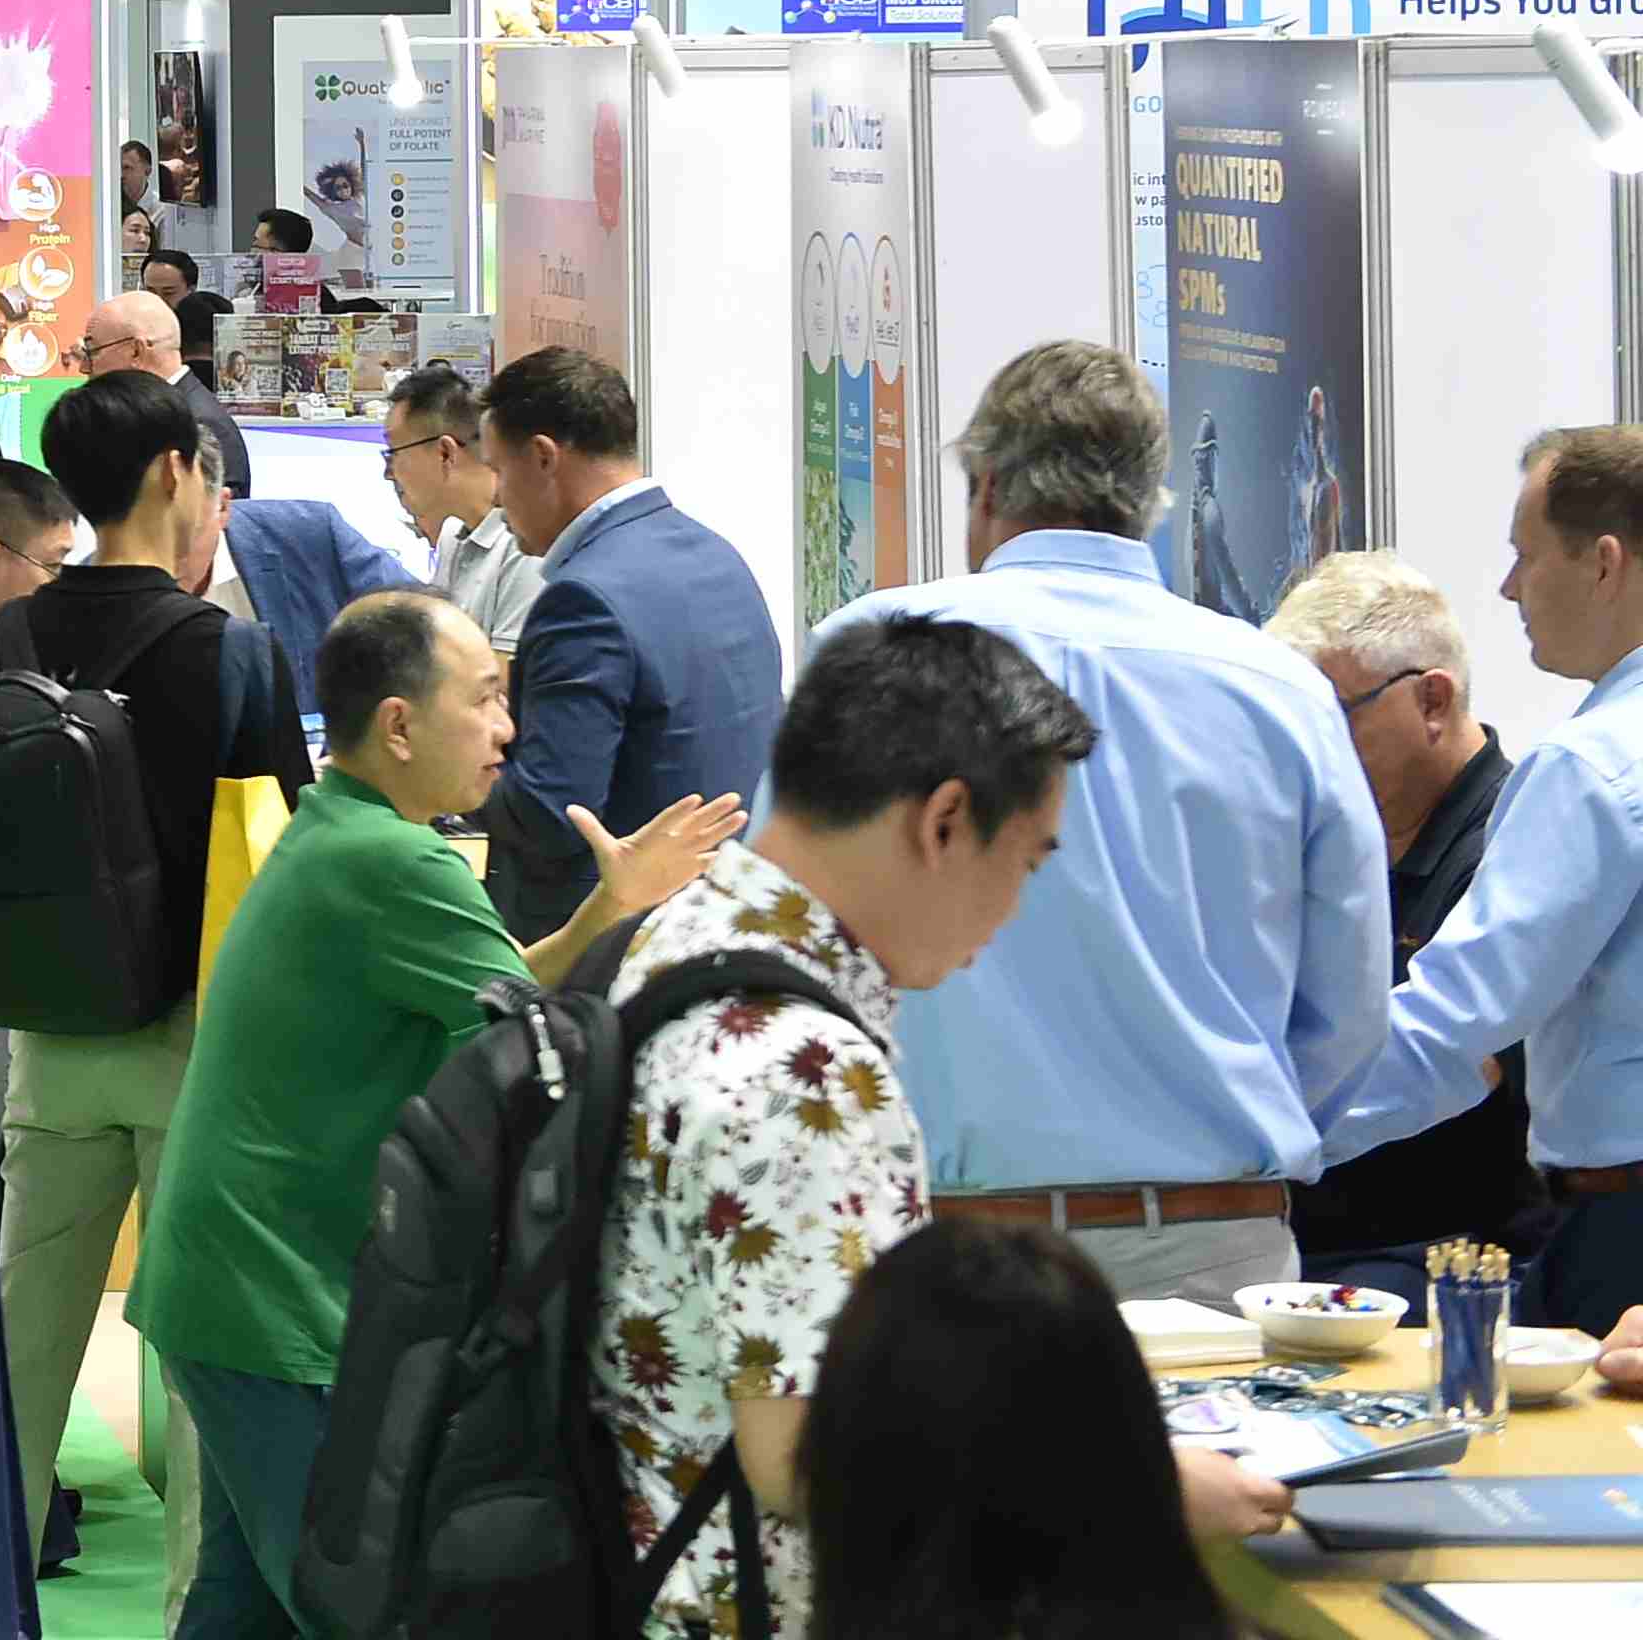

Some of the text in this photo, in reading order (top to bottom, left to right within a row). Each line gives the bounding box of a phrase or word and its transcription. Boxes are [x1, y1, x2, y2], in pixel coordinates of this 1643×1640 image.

[341, 79, 445, 97] Quatlic
[389, 129, 412, 139] FULL
[389, 142, 440, 151] OF FOLATE
[1175, 151, 1284, 204] QUANTIFIED
[28, 233, 71, 245] Protein
[1178, 210, 1262, 262] NATURAL
[1178, 267, 1226, 316] SPMs
[27, 311, 59, 323] Fiber
